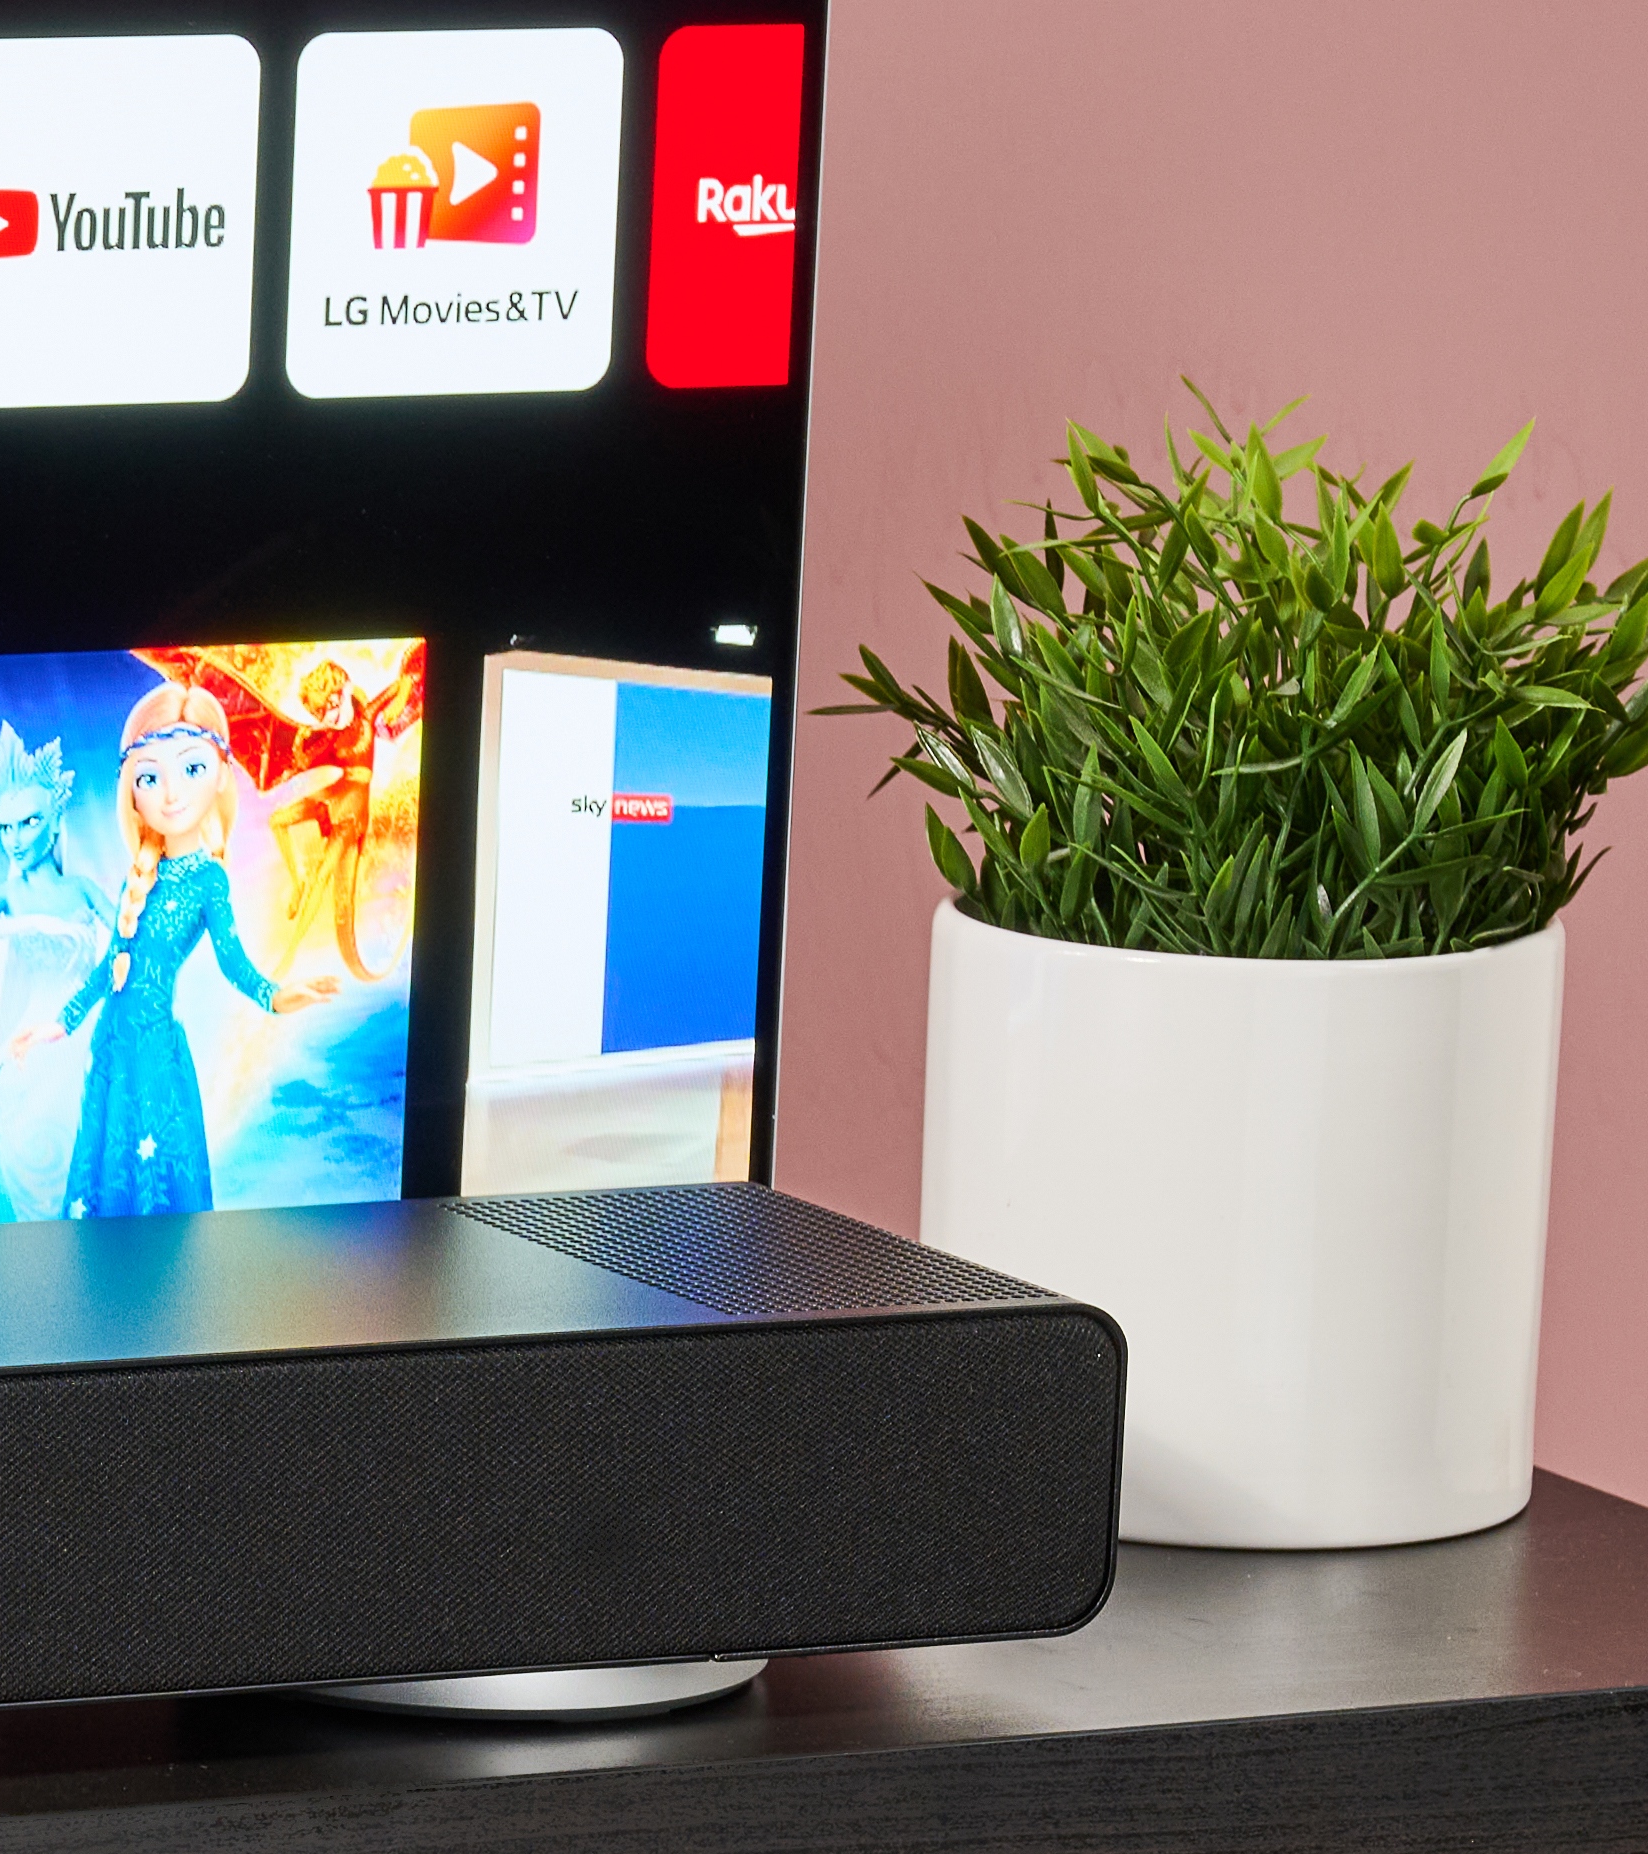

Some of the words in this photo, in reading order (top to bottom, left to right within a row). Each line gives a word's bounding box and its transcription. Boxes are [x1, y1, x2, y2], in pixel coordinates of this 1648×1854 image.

[49, 187, 226, 253] YouTube
[324, 295, 369, 327] LG
[379, 290, 579, 326] Movies&TV
[571, 795, 608, 817] sky
